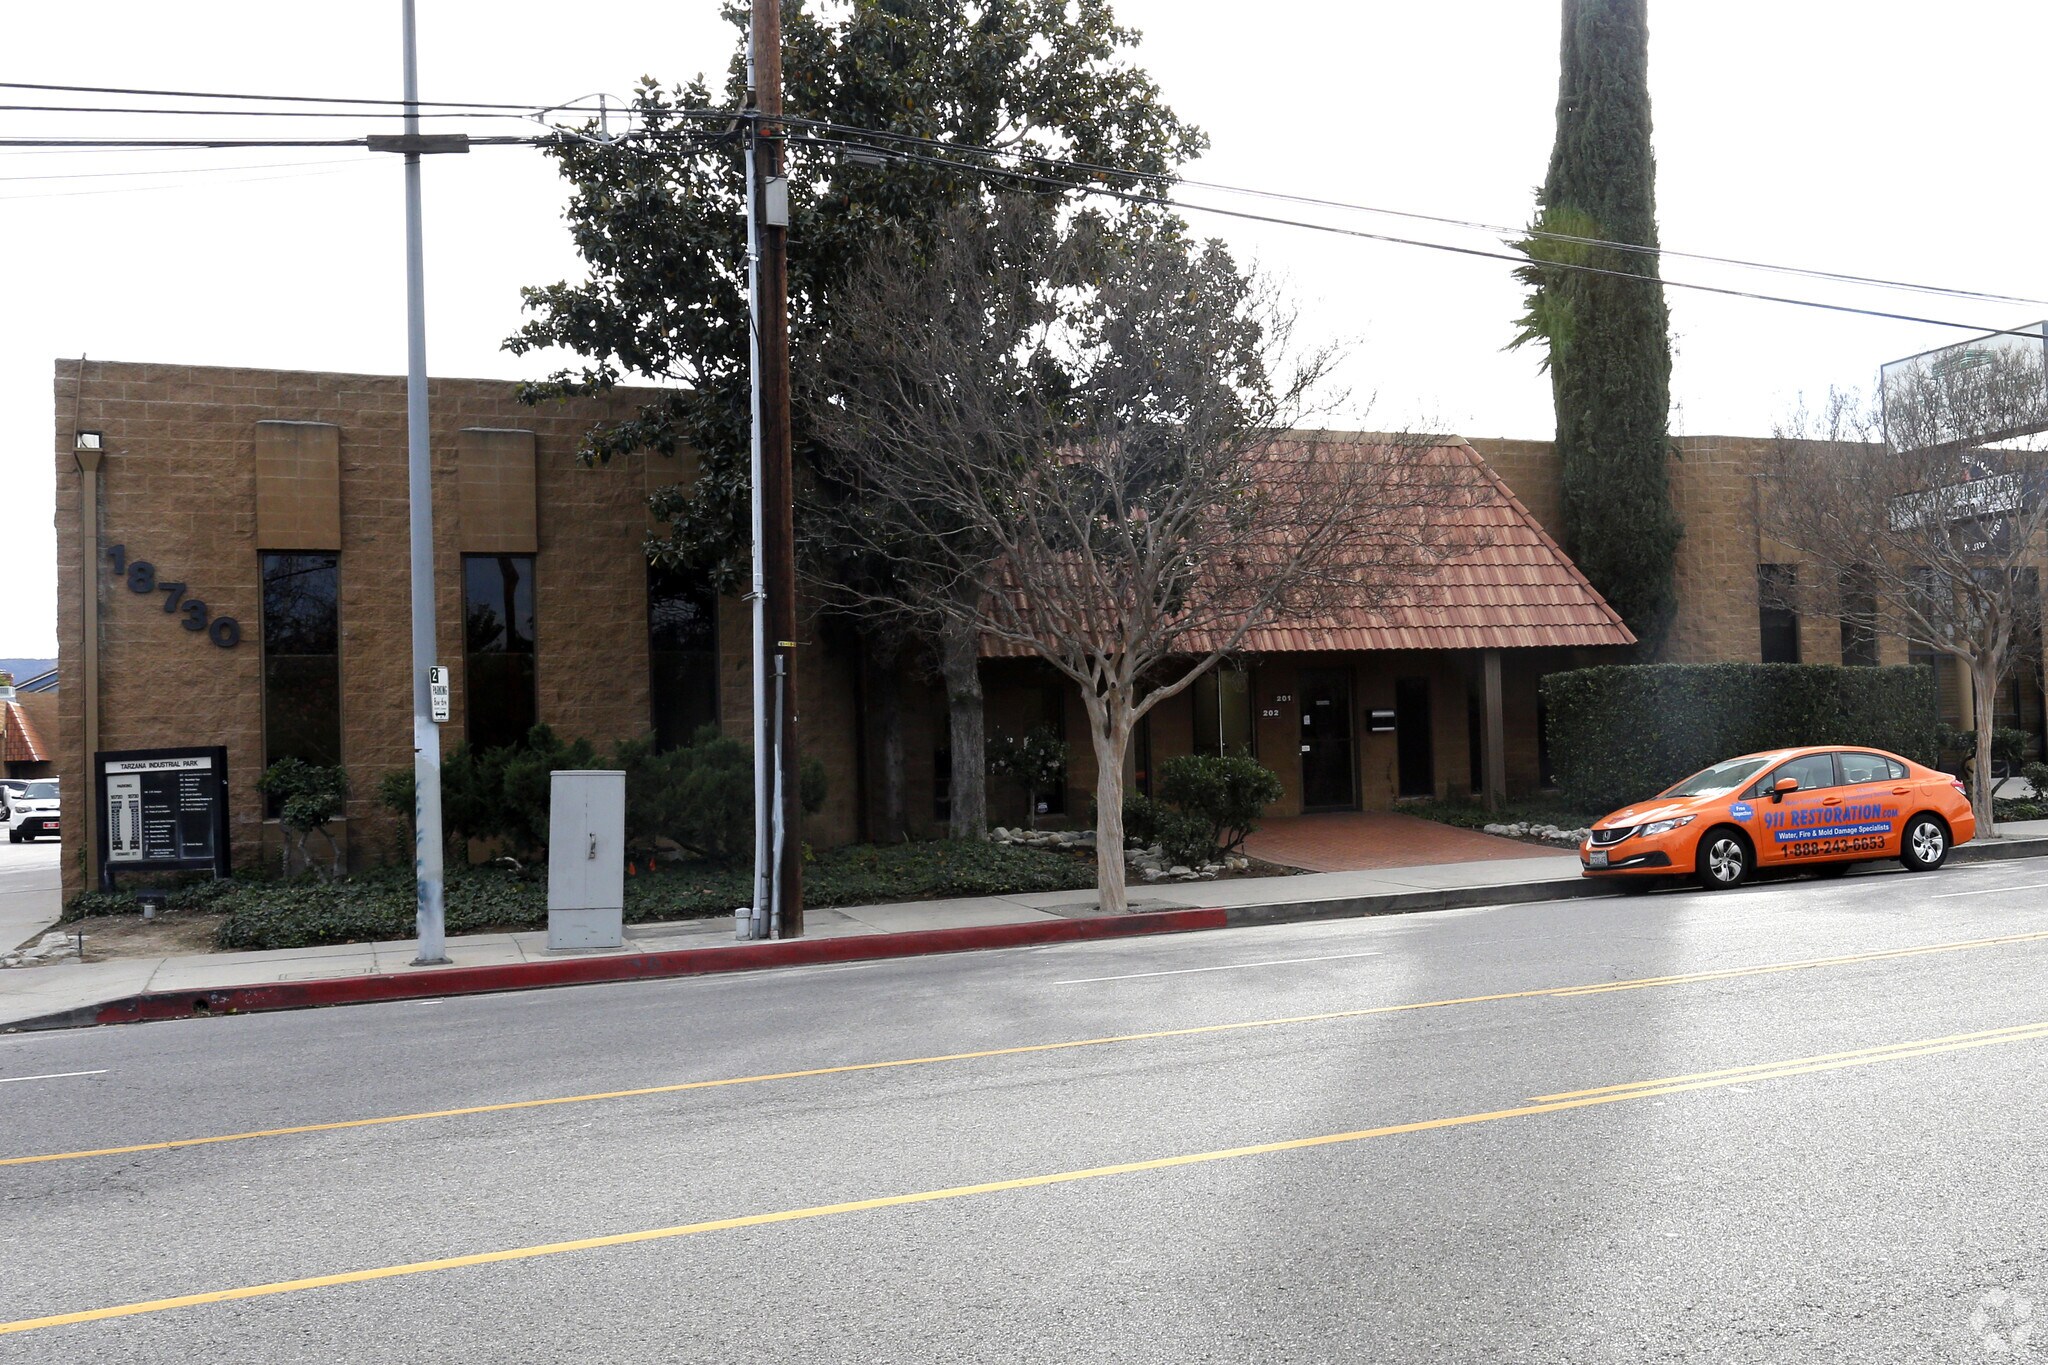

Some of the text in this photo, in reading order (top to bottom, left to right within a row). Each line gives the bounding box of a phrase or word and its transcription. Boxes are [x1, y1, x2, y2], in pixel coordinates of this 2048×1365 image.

[107, 544, 241, 648] 18730
[432, 669, 438, 681] 2
[1764, 812, 1785, 829] 911
[1778, 832, 1798, 840] Water,
[1818, 828, 1833, 836] Mold
[1834, 826, 1858, 836] Damage
[1858, 823, 1890, 833] Specialists
[1781, 836, 1885, 858] 1-888-243-6653
